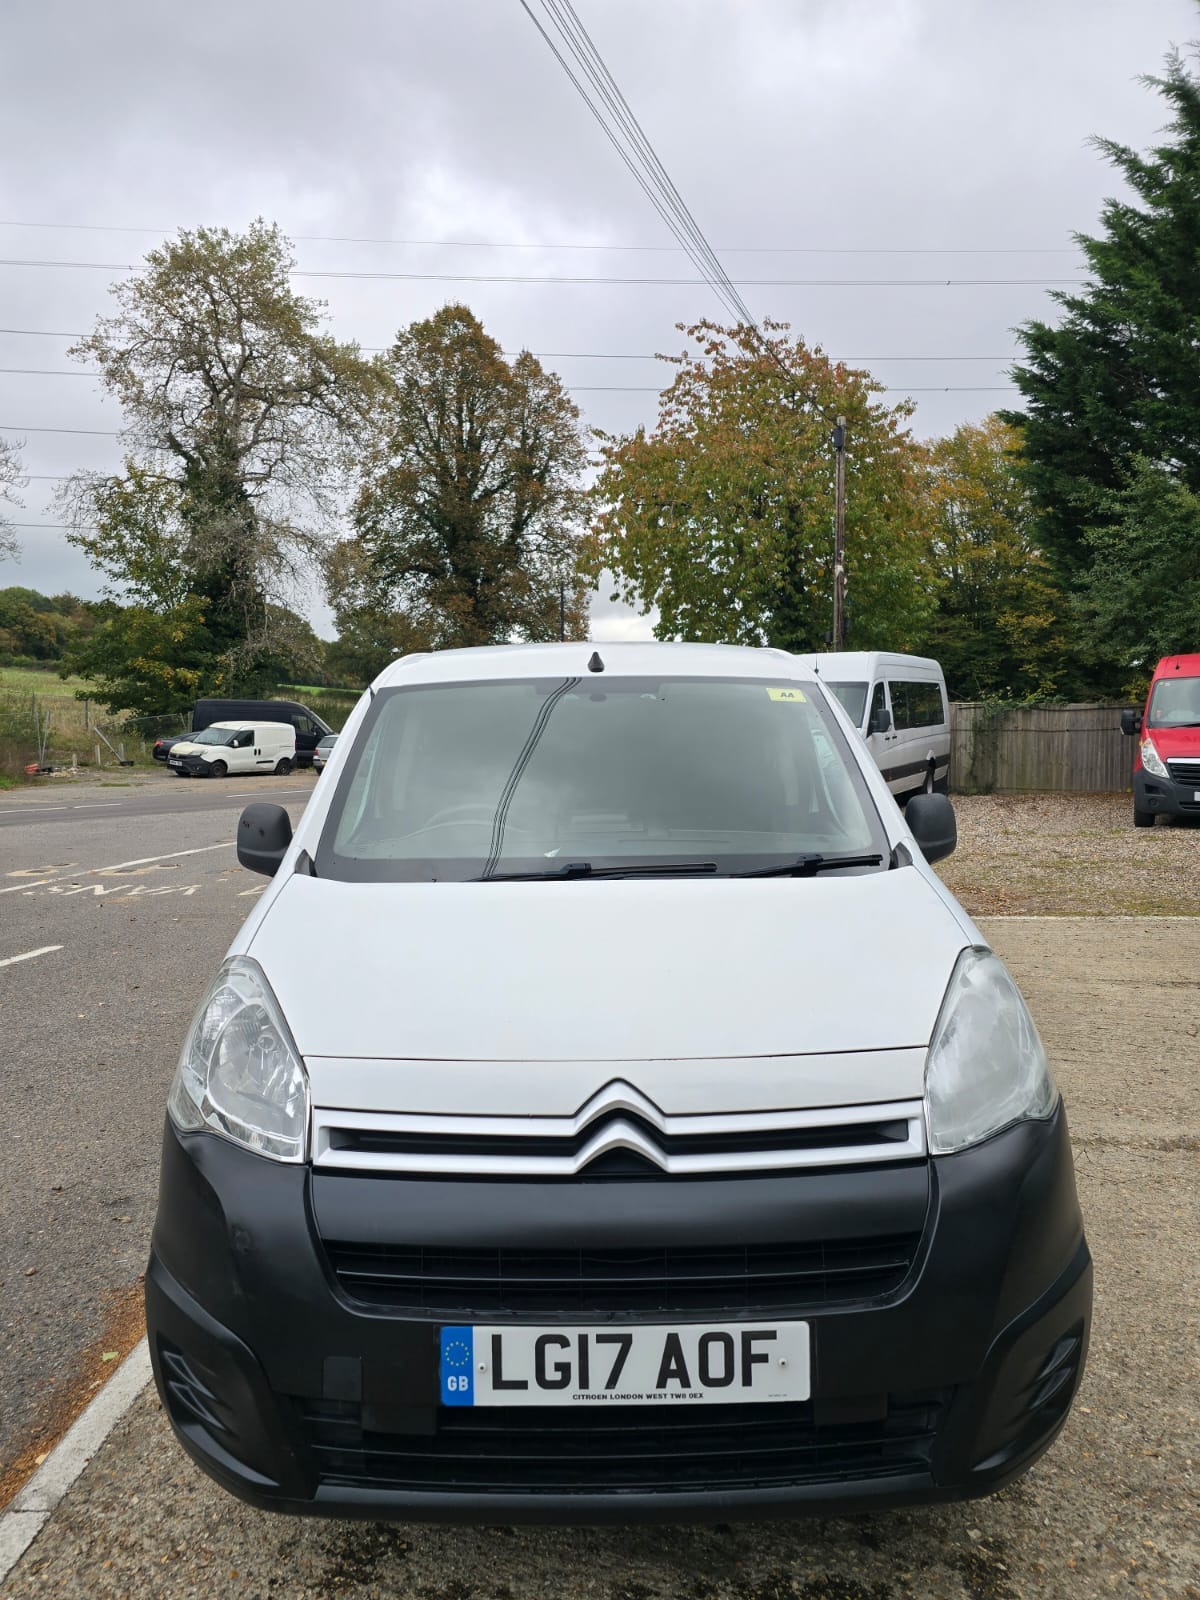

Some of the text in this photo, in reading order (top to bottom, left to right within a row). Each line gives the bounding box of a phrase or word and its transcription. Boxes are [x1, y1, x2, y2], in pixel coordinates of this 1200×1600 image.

[491, 1330, 778, 1391] LG17 AOF
[447, 1375, 469, 1392] GB
